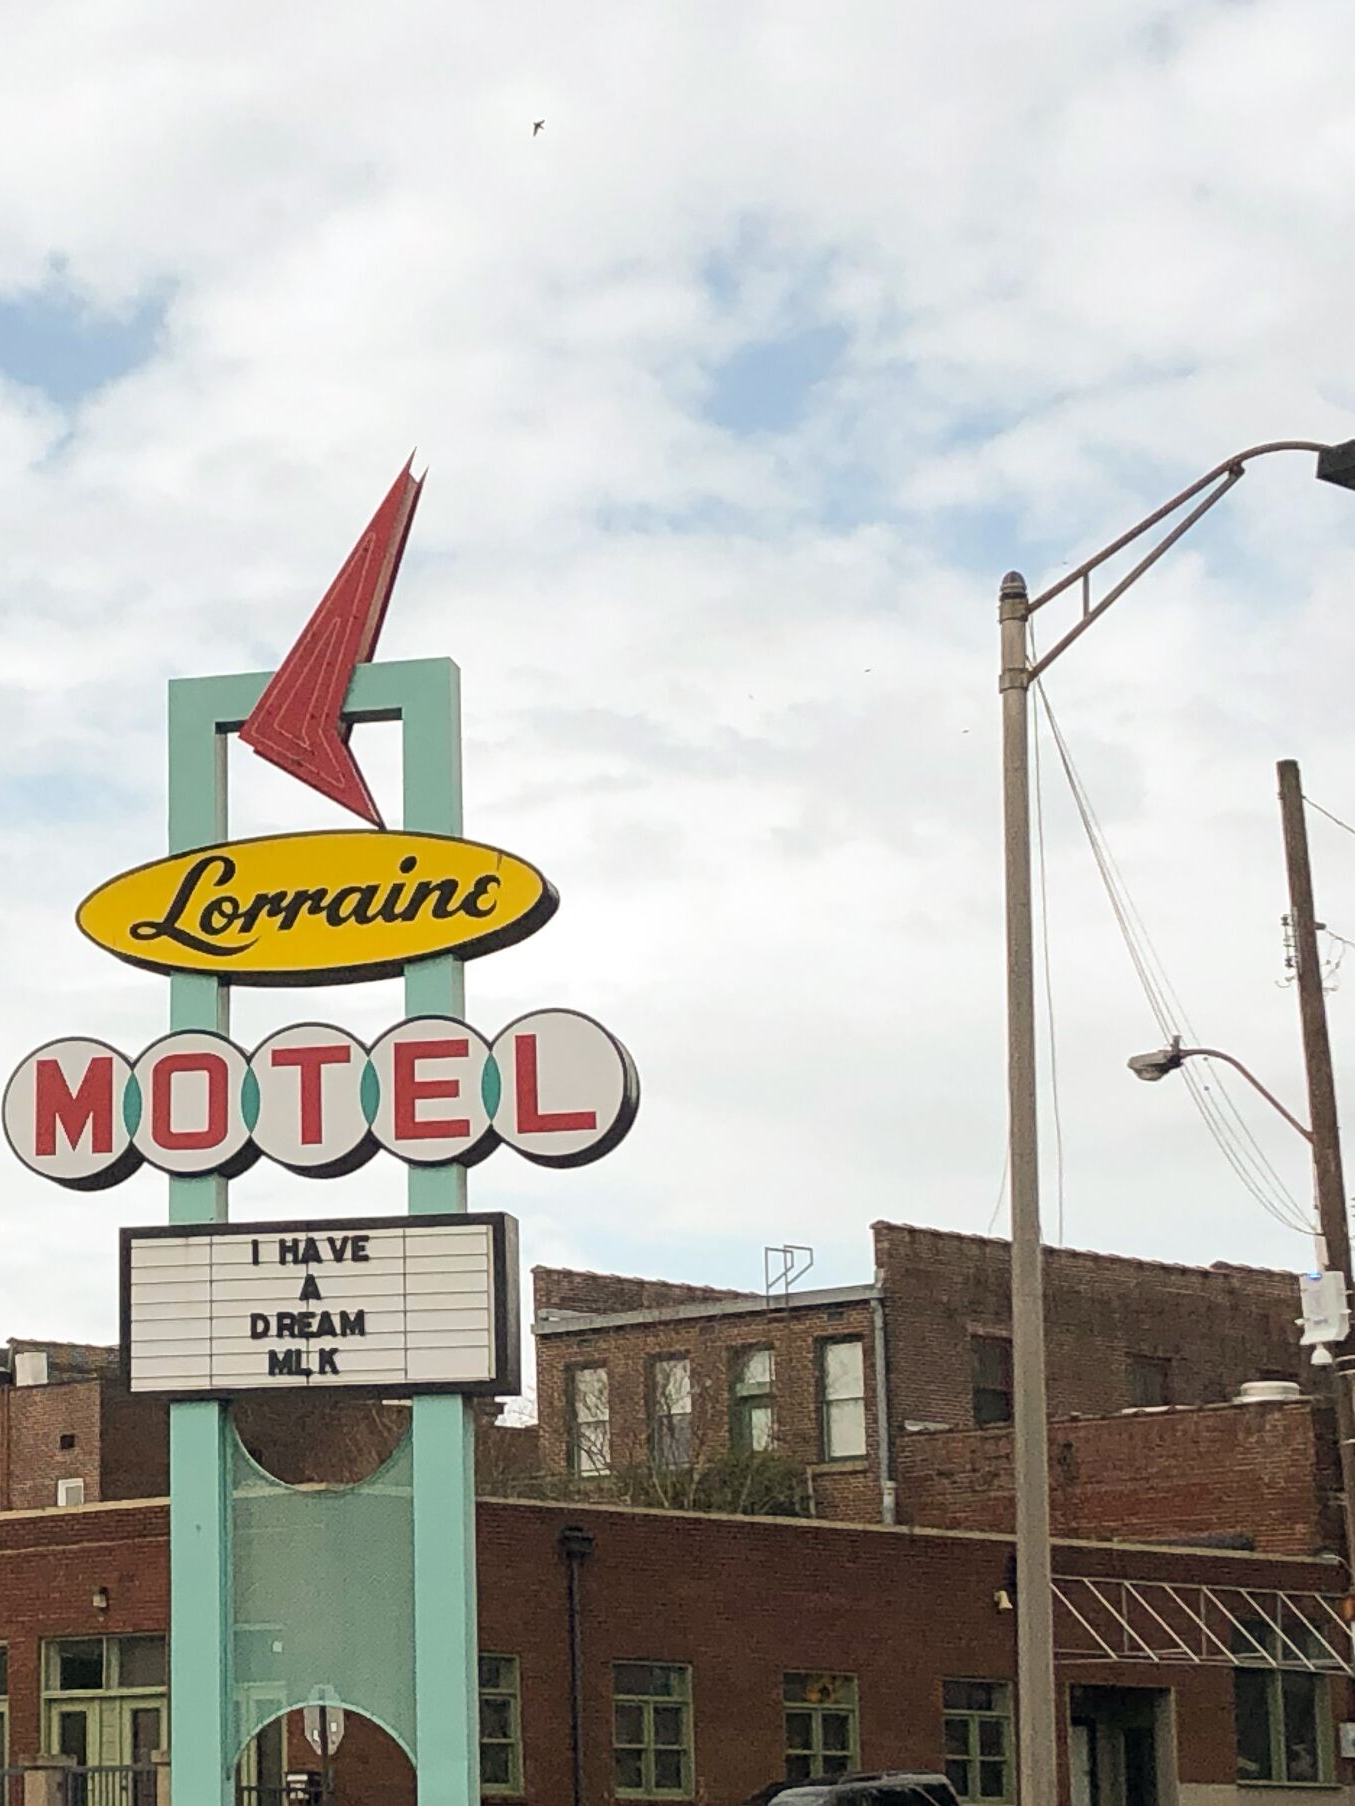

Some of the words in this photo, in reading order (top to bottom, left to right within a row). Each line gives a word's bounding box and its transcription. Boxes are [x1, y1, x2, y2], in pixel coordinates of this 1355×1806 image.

[129, 855, 502, 957] Lorraine
[35, 1033, 597, 1157] MOTEL
[250, 1239, 260, 1266] I
[278, 1235, 371, 1265] HAVE
[299, 1273, 322, 1300] A
[250, 1308, 366, 1340] DREAM
[268, 1347, 340, 1377] MLK
